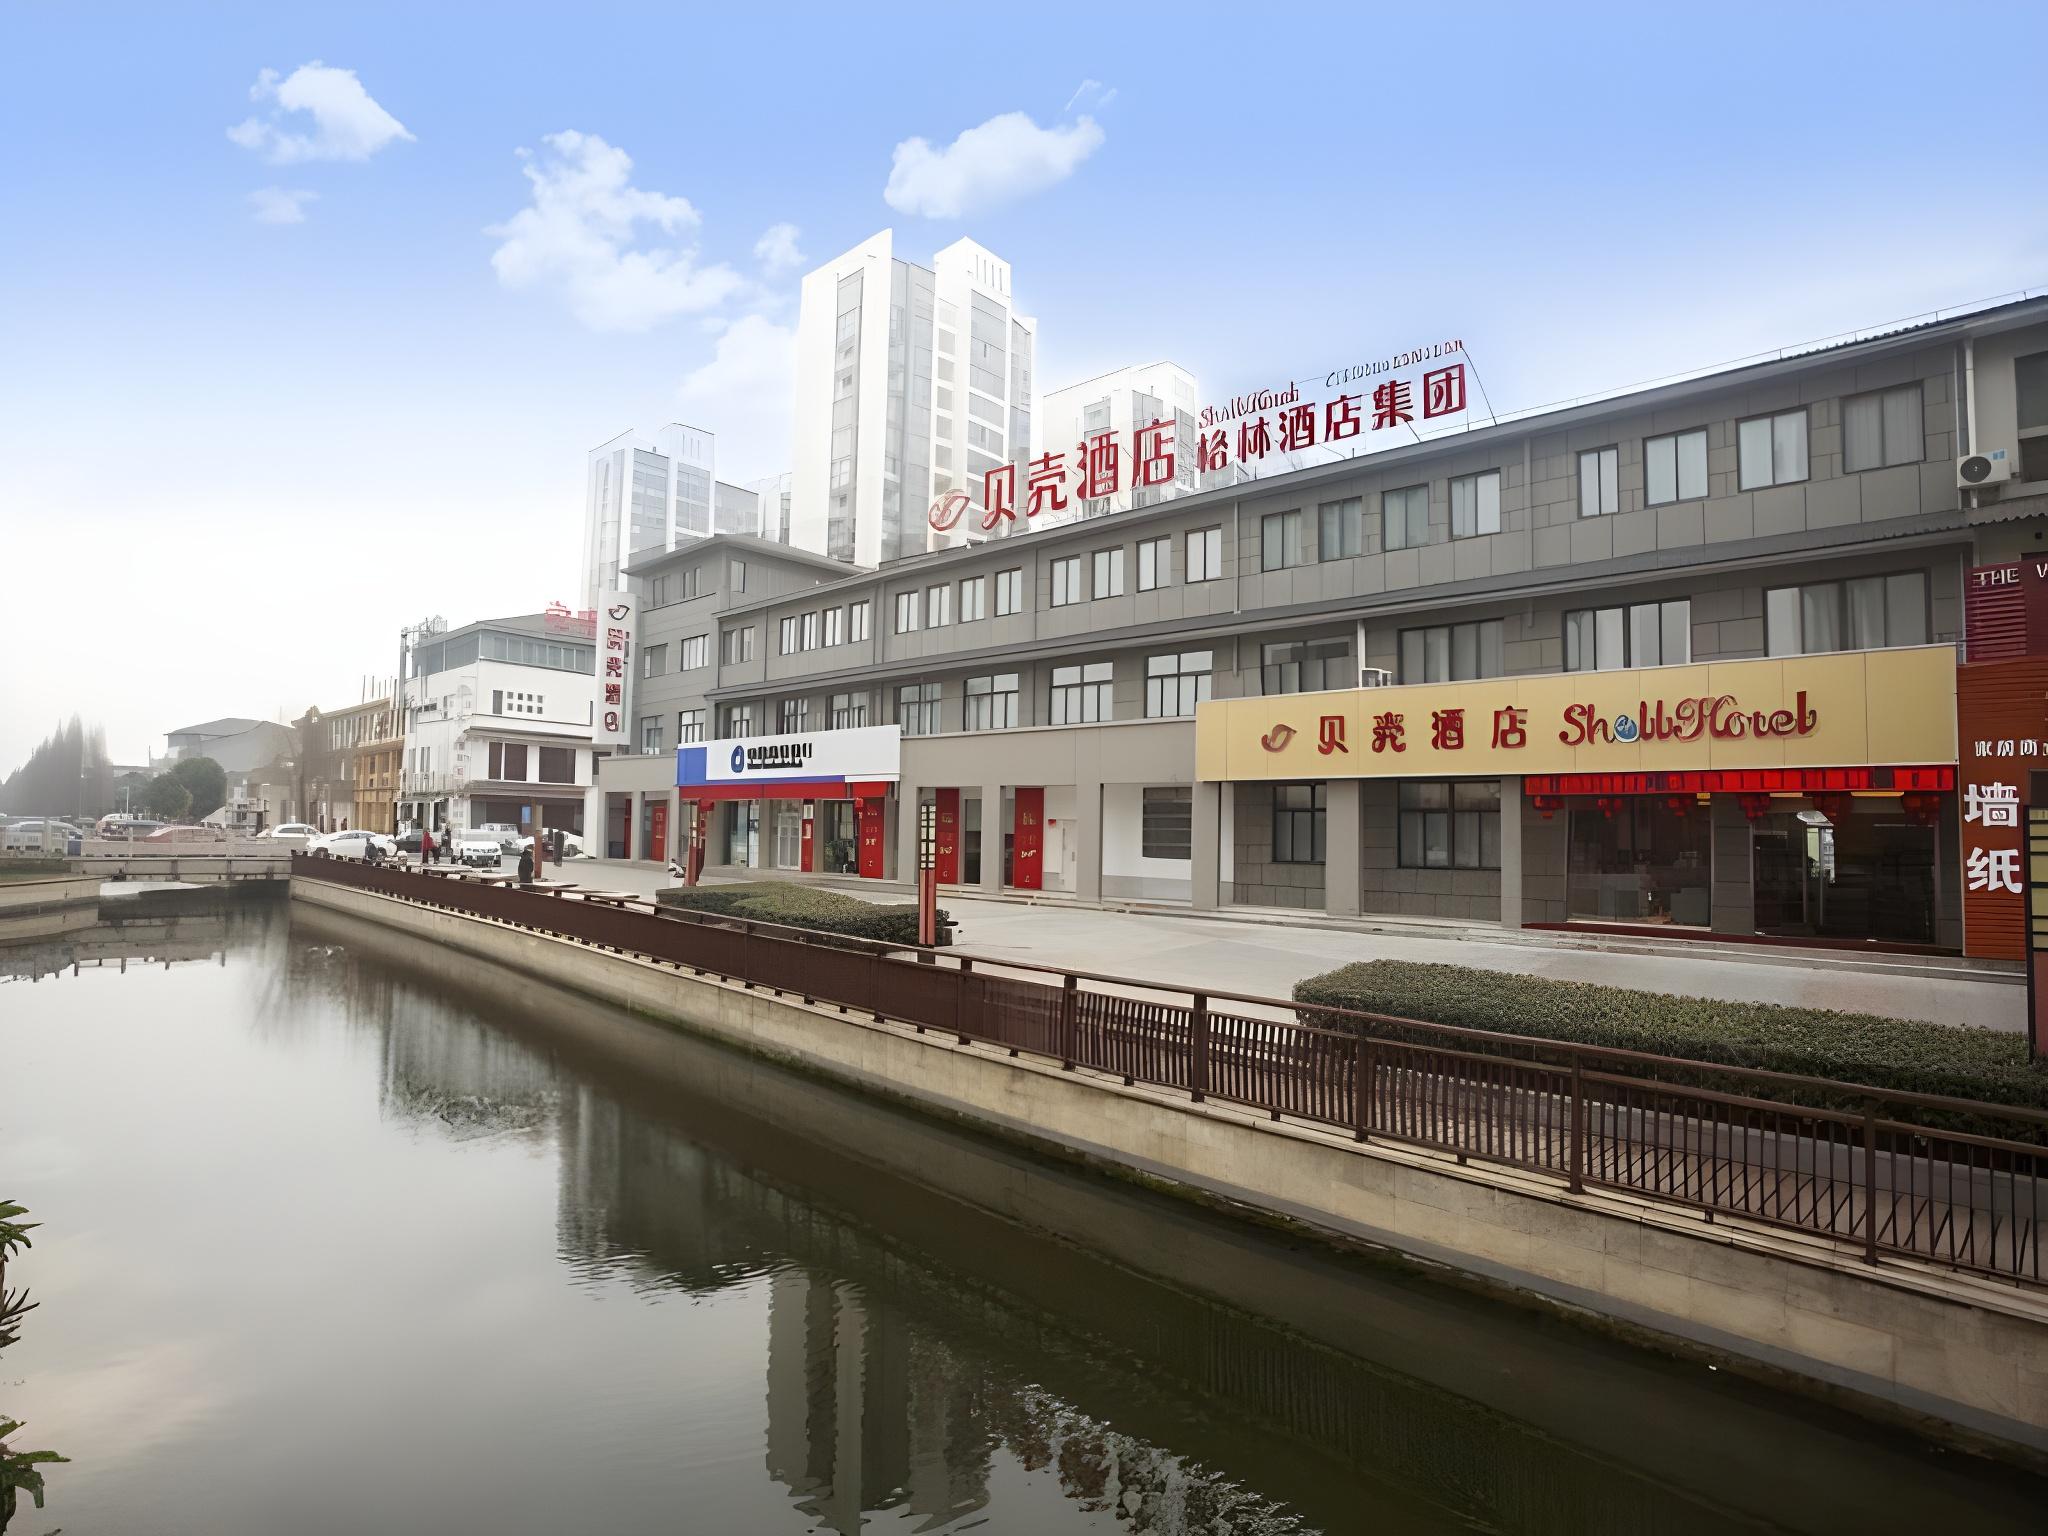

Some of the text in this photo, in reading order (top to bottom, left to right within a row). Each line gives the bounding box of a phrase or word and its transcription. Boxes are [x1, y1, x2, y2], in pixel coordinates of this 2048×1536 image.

[981, 418, 1176, 531] 贝壳酒店
[1964, 782, 2023, 894] 墙纸
